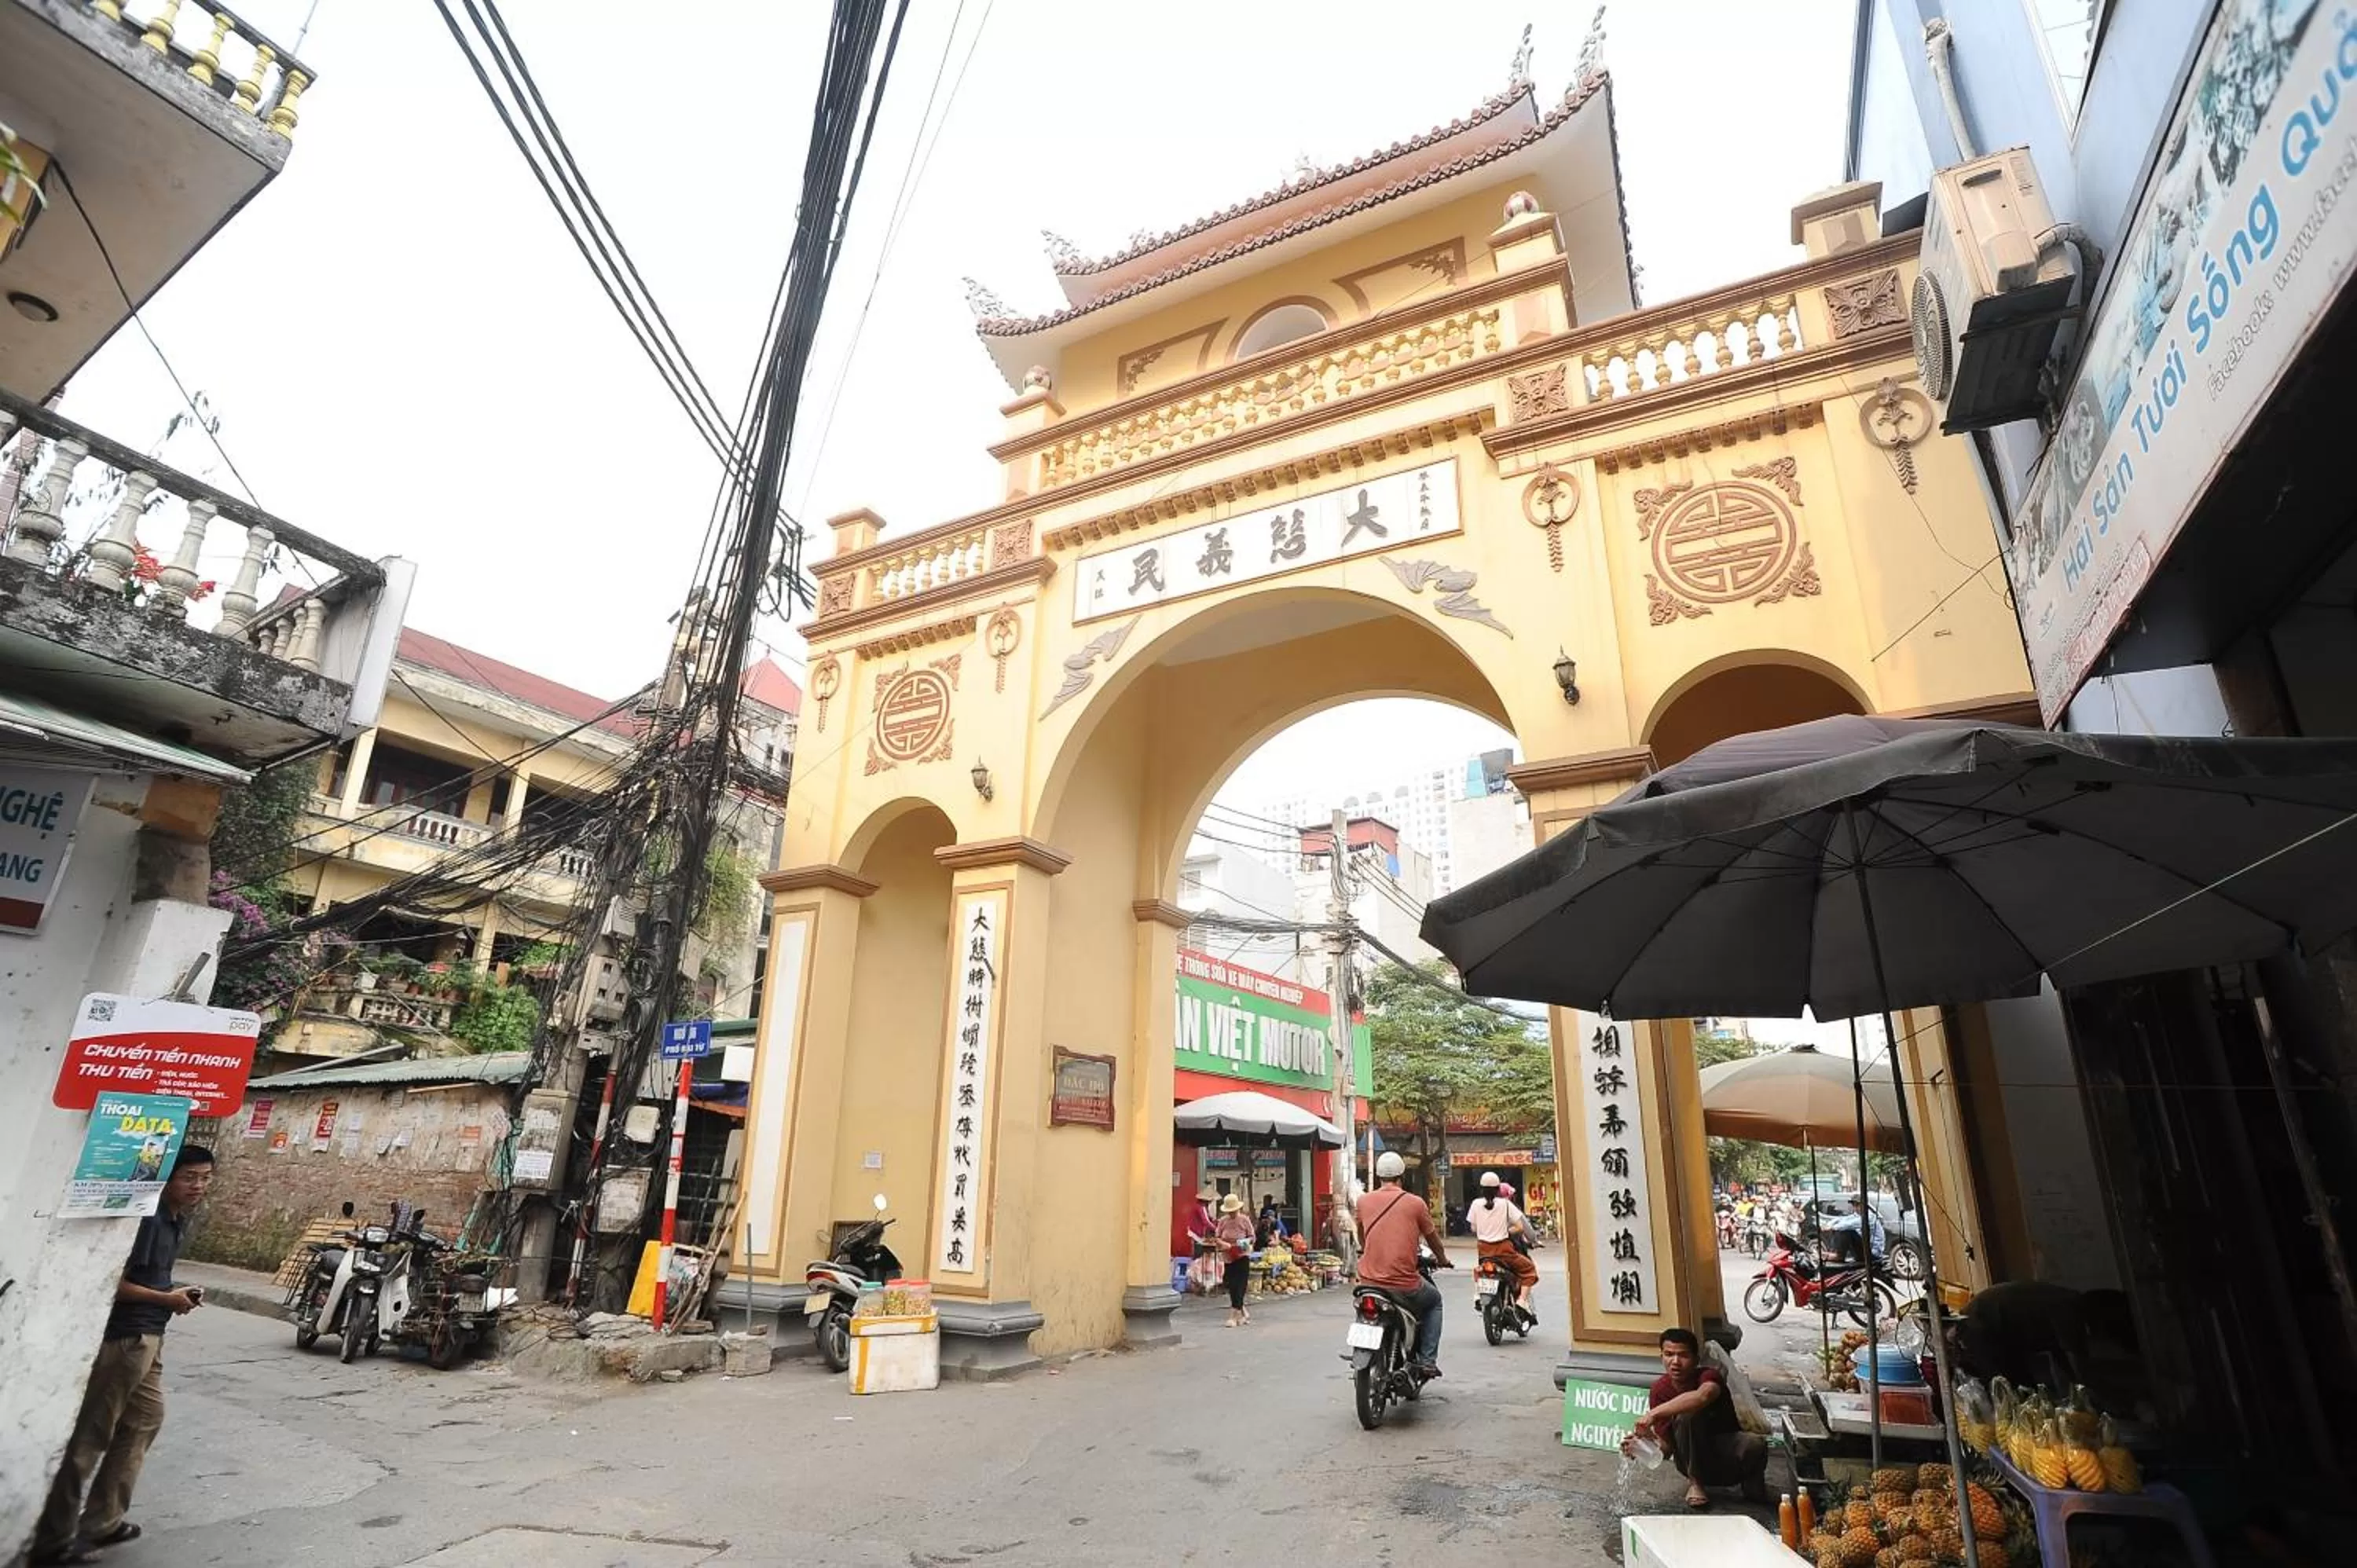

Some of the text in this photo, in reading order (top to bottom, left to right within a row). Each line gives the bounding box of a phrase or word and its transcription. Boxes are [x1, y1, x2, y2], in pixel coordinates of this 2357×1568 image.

[2062, 516, 2094, 592] Hải
[2092, 452, 2134, 536] Sản
[2131, 339, 2187, 454] Tươi
[2187, 181, 2280, 354] Sống
[0, 787, 64, 840] GHỆ
[1206, 995, 1256, 1072] VIỆT
[1259, 1015, 1326, 1075] MOTOR
[79, 1063, 115, 1077] THU
[188, 1053, 241, 1068] NHANH
[120, 1116, 172, 1133] DATA
[1574, 1385, 1618, 1412] NƯỚC
[1571, 1421, 1633, 1448] NGUYÊ
